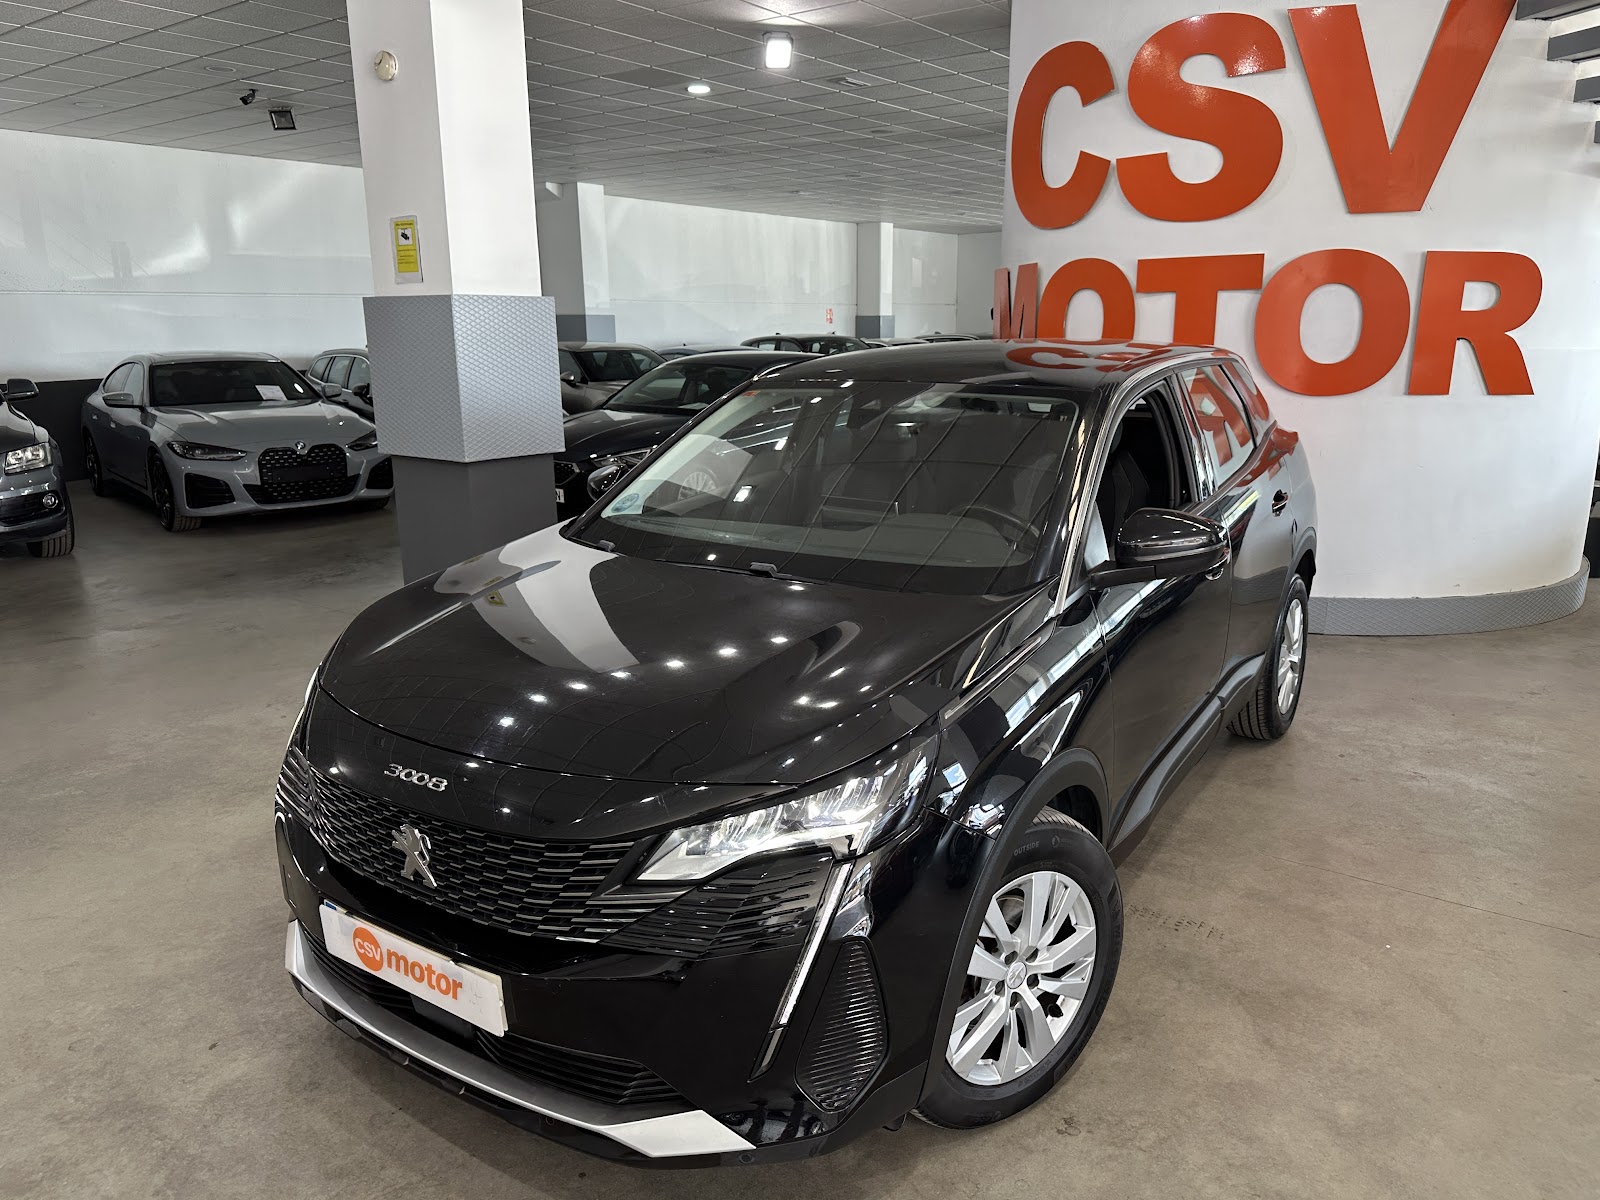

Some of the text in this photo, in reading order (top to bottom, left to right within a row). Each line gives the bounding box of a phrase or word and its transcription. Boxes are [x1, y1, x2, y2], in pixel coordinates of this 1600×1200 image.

[1010, 0, 1518, 230] CSV
[993, 248, 1543, 397] MOTOR
[384, 763, 448, 791] 3008
[1014, 841, 1040, 856] OUTSIDE
[354, 938, 381, 961] CSV
[386, 948, 463, 1000] motor
